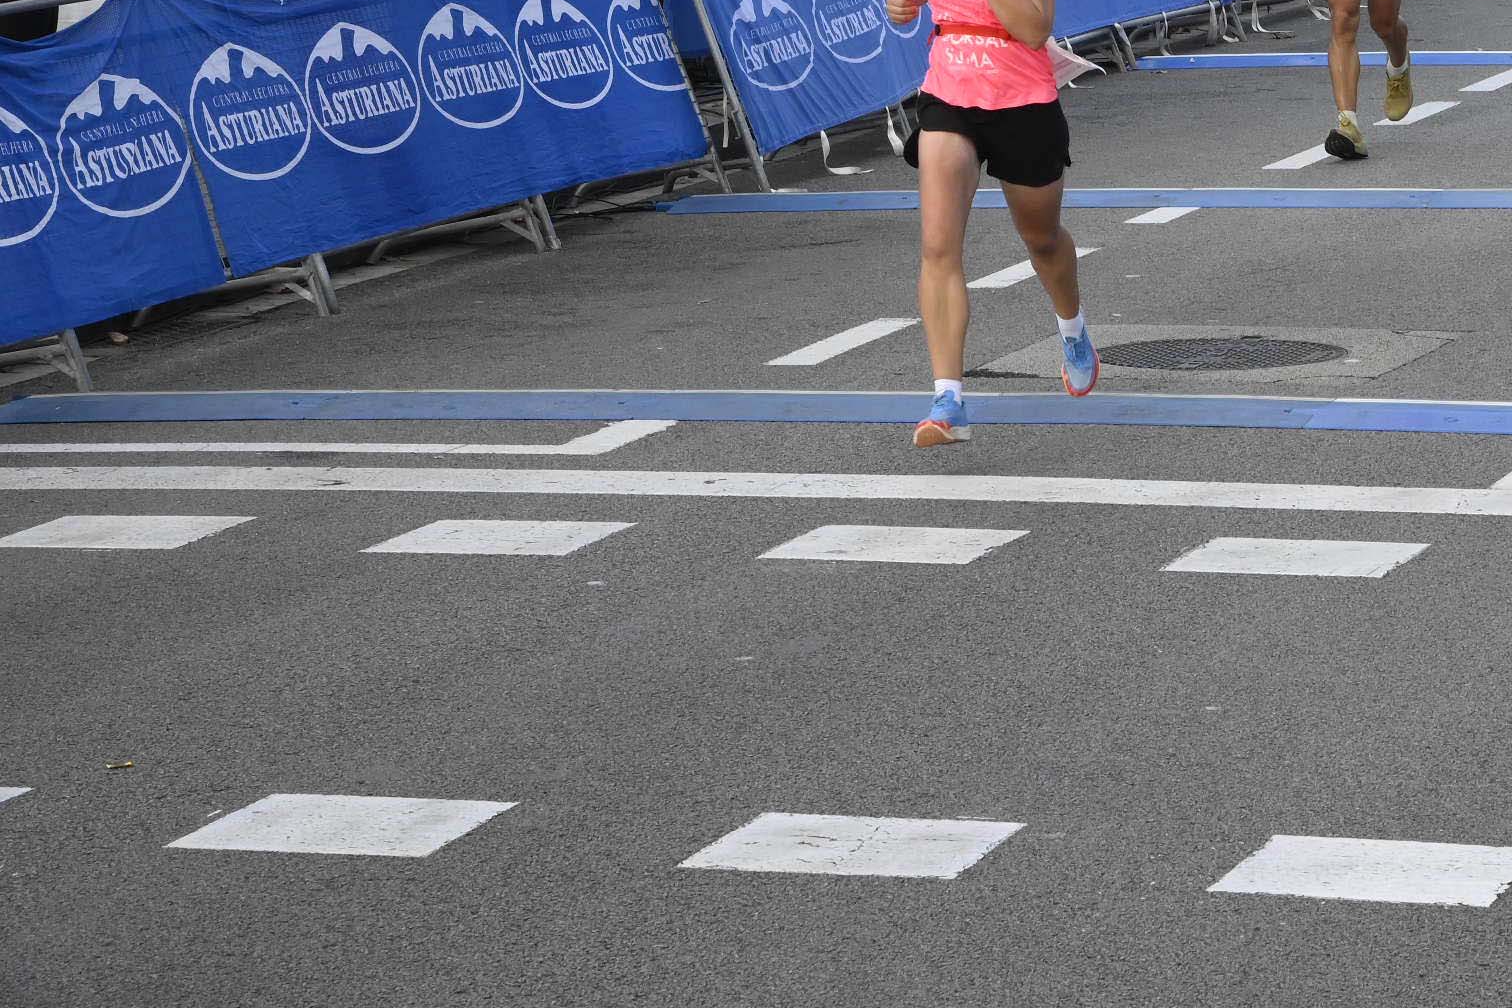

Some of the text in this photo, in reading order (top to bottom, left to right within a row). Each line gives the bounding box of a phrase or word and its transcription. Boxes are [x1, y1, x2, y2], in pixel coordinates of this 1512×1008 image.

[439, 40, 504, 61] CENTRAL LECHERA
[531, 27, 592, 46] CENTRAL LECHERA
[326, 60, 400, 85] CENTRAL LECHERA
[428, 54, 519, 102] ASTURIANA
[524, 39, 608, 83] ASTURIANA
[213, 84, 290, 107] CENTRAL LECHERA
[315, 77, 415, 128] ASTURIANA
[80, 124, 123, 142] CENTRAL
[202, 100, 305, 153] ASTURIANA
[68, 130, 182, 190] ASTURIANA
